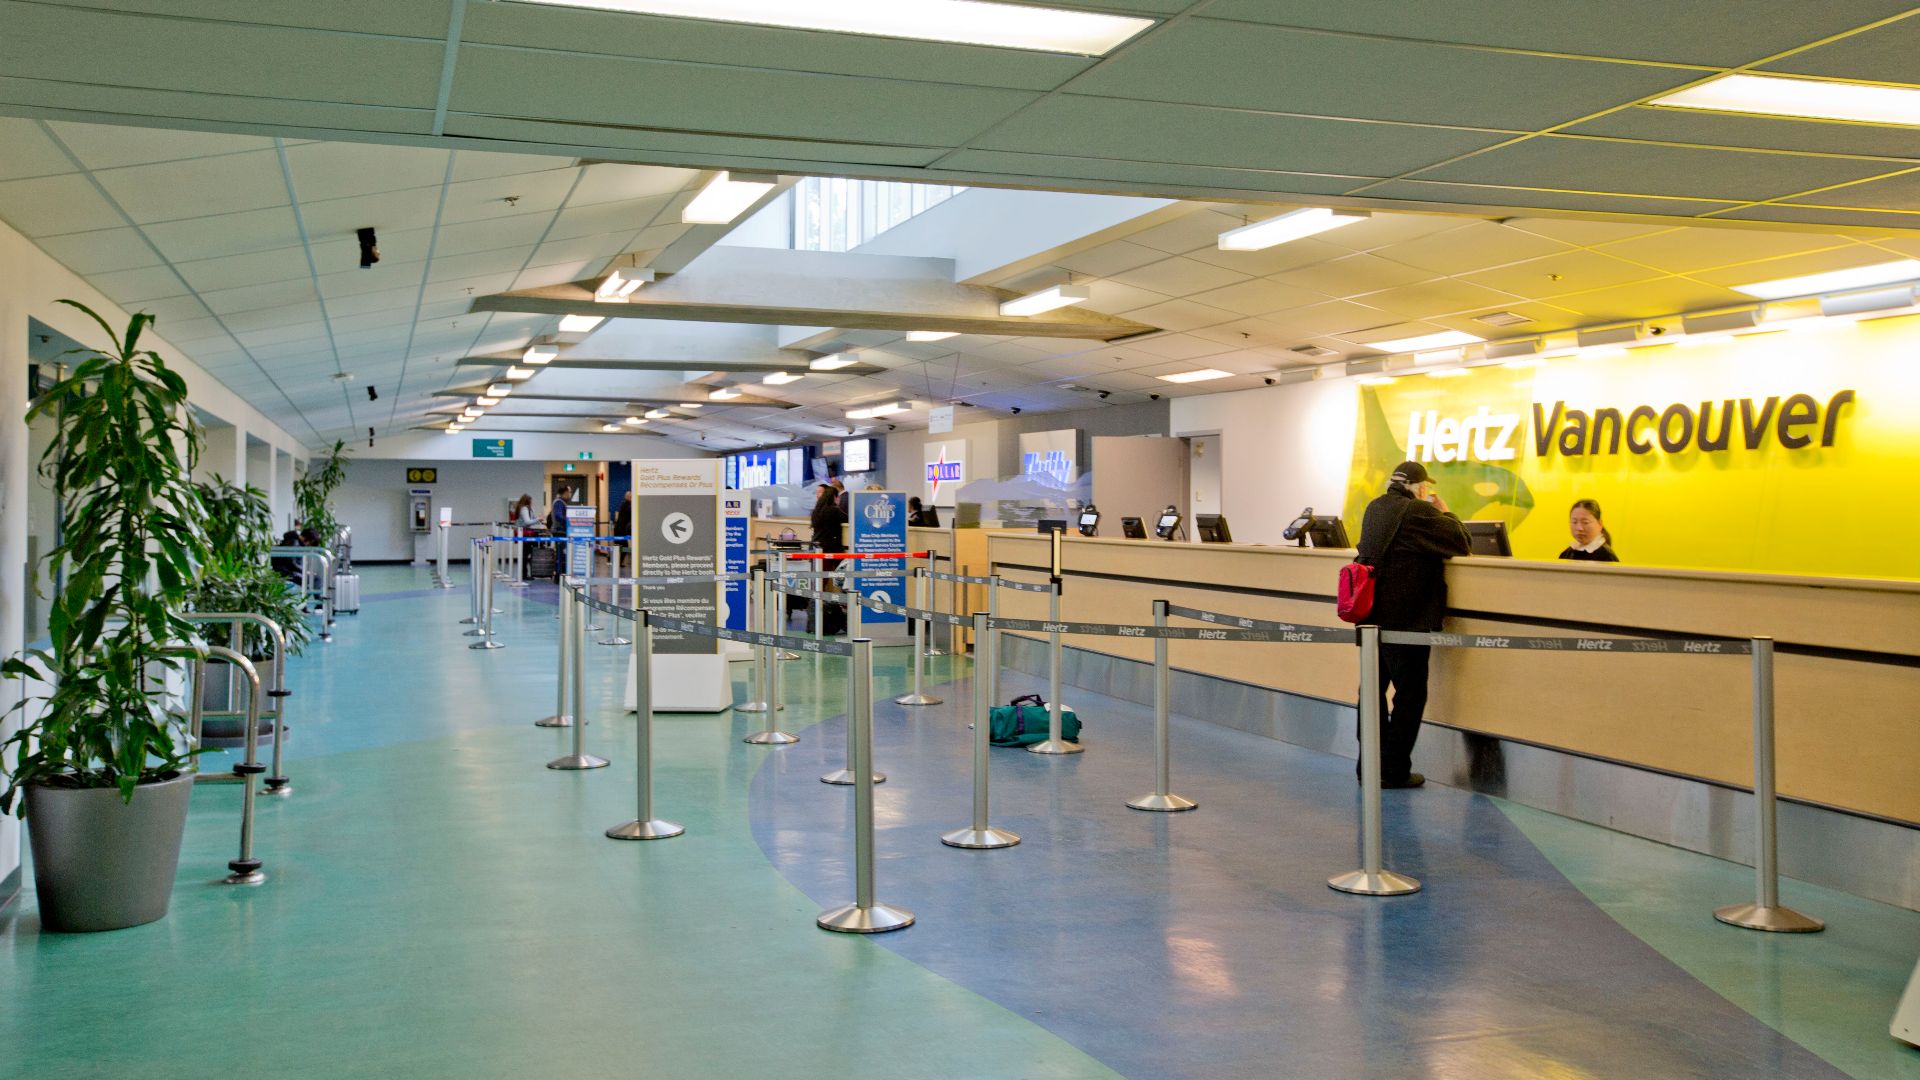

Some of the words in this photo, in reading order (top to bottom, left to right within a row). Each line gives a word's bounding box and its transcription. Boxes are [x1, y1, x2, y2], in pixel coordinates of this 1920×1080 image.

[1406, 406, 1517, 462] Hertz
[1533, 389, 1856, 458] Vancouver
[928, 464, 960, 480] DOLLAR
[1042, 622, 1068, 634] Hertz
[1118, 625, 1145, 637] Hertz
[1199, 629, 1227, 640] Hertz
[1283, 631, 1312, 642] Hertz
[759, 635, 774, 645] Hertz
[803, 641, 820, 652] Hertz
[1476, 635, 1510, 648] Hertz
[1577, 638, 1612, 651] Hertz
[1684, 641, 1721, 654] Hertz
